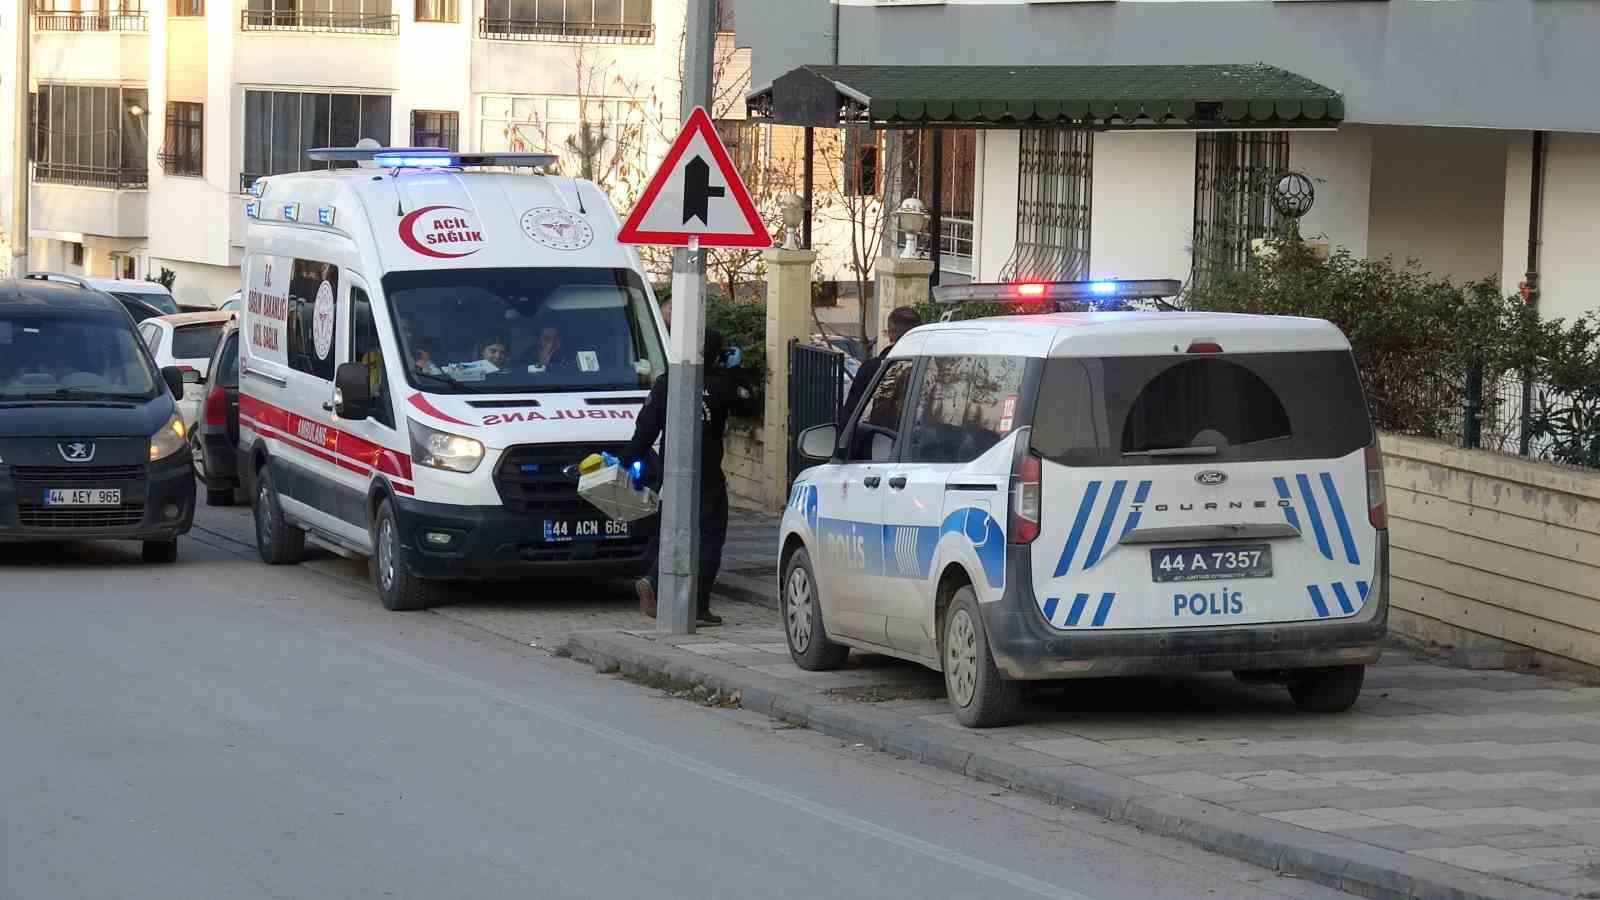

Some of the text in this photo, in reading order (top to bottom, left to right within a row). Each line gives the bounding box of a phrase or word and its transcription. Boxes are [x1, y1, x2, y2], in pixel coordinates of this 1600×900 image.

[433, 217, 469, 230] ACİL
[426, 231, 483, 245] SAĞLIK
[297, 418, 327, 447] AMBULANS
[49, 490, 119, 503] 44 AEY 965
[1131, 500, 1290, 512] TOURNEO
[553, 521, 568, 536] 44
[576, 520, 598, 535] ACN
[1160, 551, 1262, 571] 44 A 7357
[1174, 587, 1243, 616] POLİS
